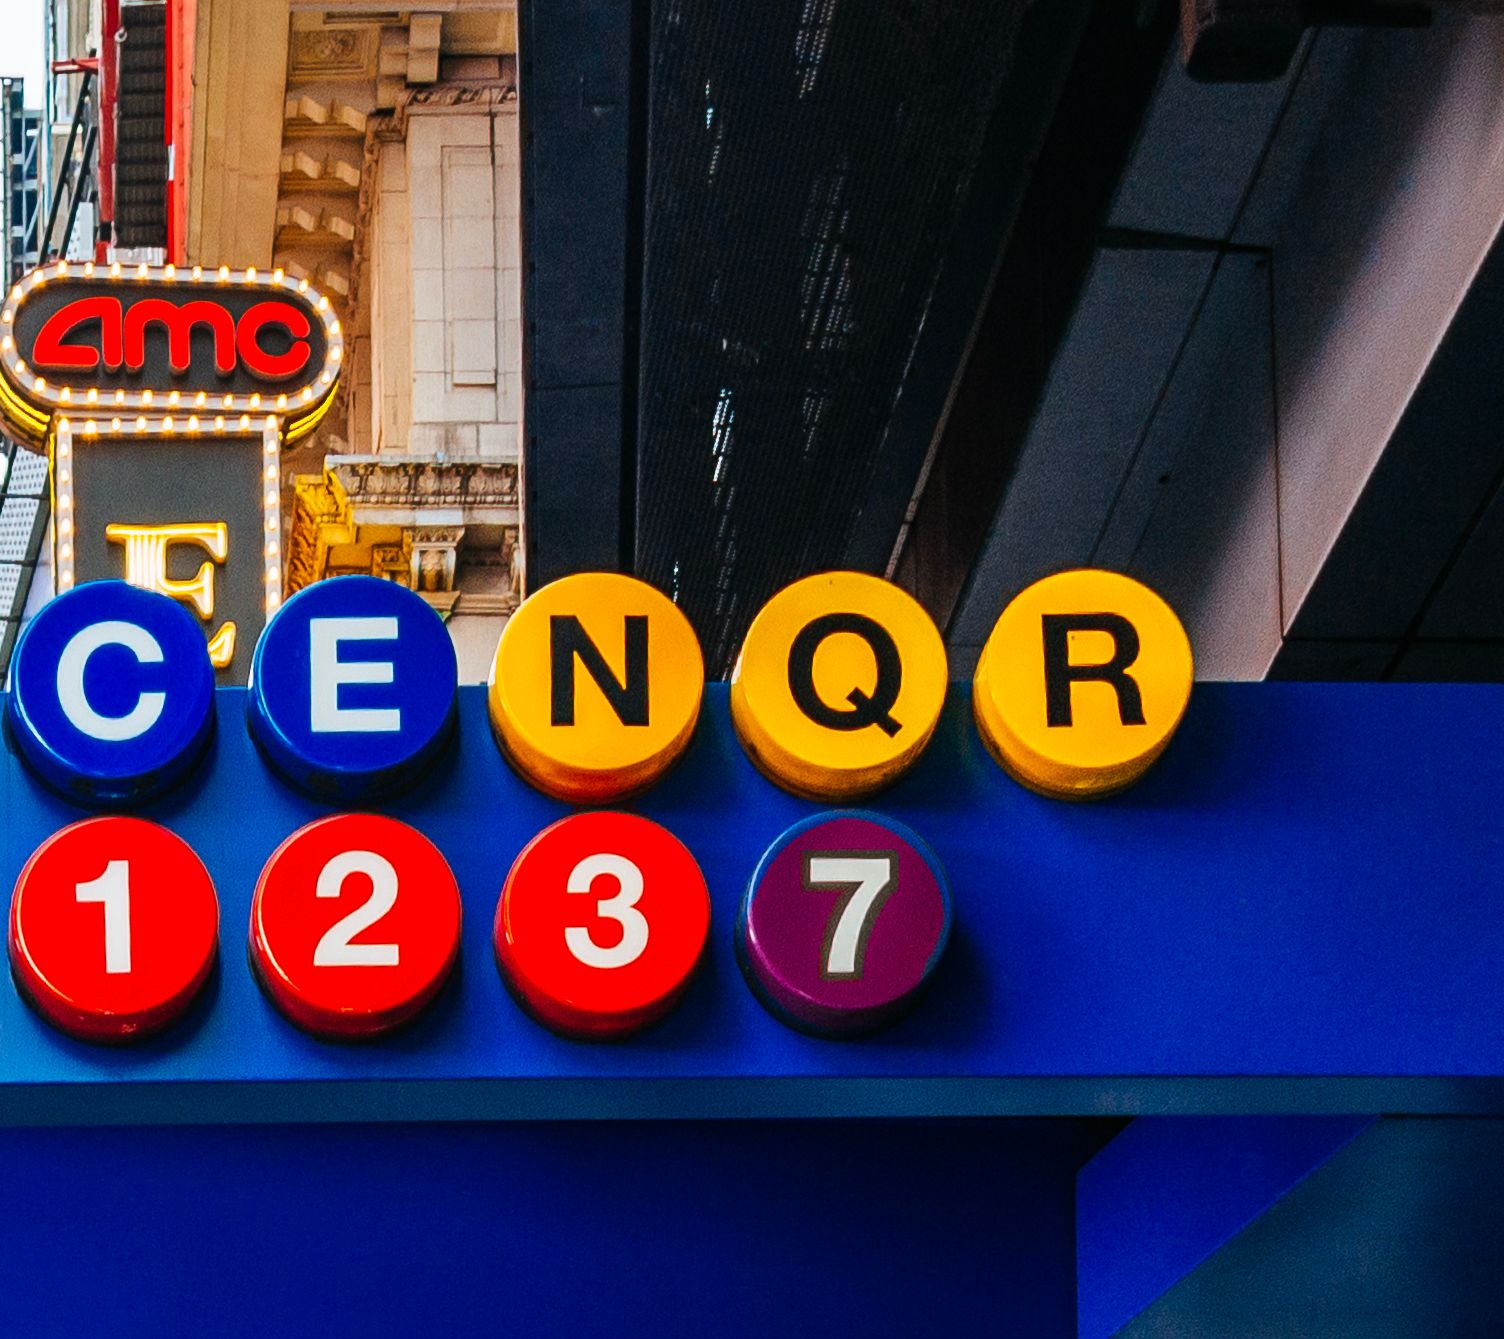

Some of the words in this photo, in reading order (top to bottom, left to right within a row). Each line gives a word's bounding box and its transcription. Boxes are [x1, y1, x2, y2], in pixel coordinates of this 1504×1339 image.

[33, 296, 313, 379] amc
[54, 620, 166, 741] C
[310, 616, 402, 733] E
[549, 613, 650, 727] N
[787, 613, 902, 738] Q
[1043, 612, 1147, 728] R
[73, 859, 133, 974] 1
[312, 850, 401, 967] 2
[562, 853, 649, 968] 3
[811, 854, 894, 979] 7
